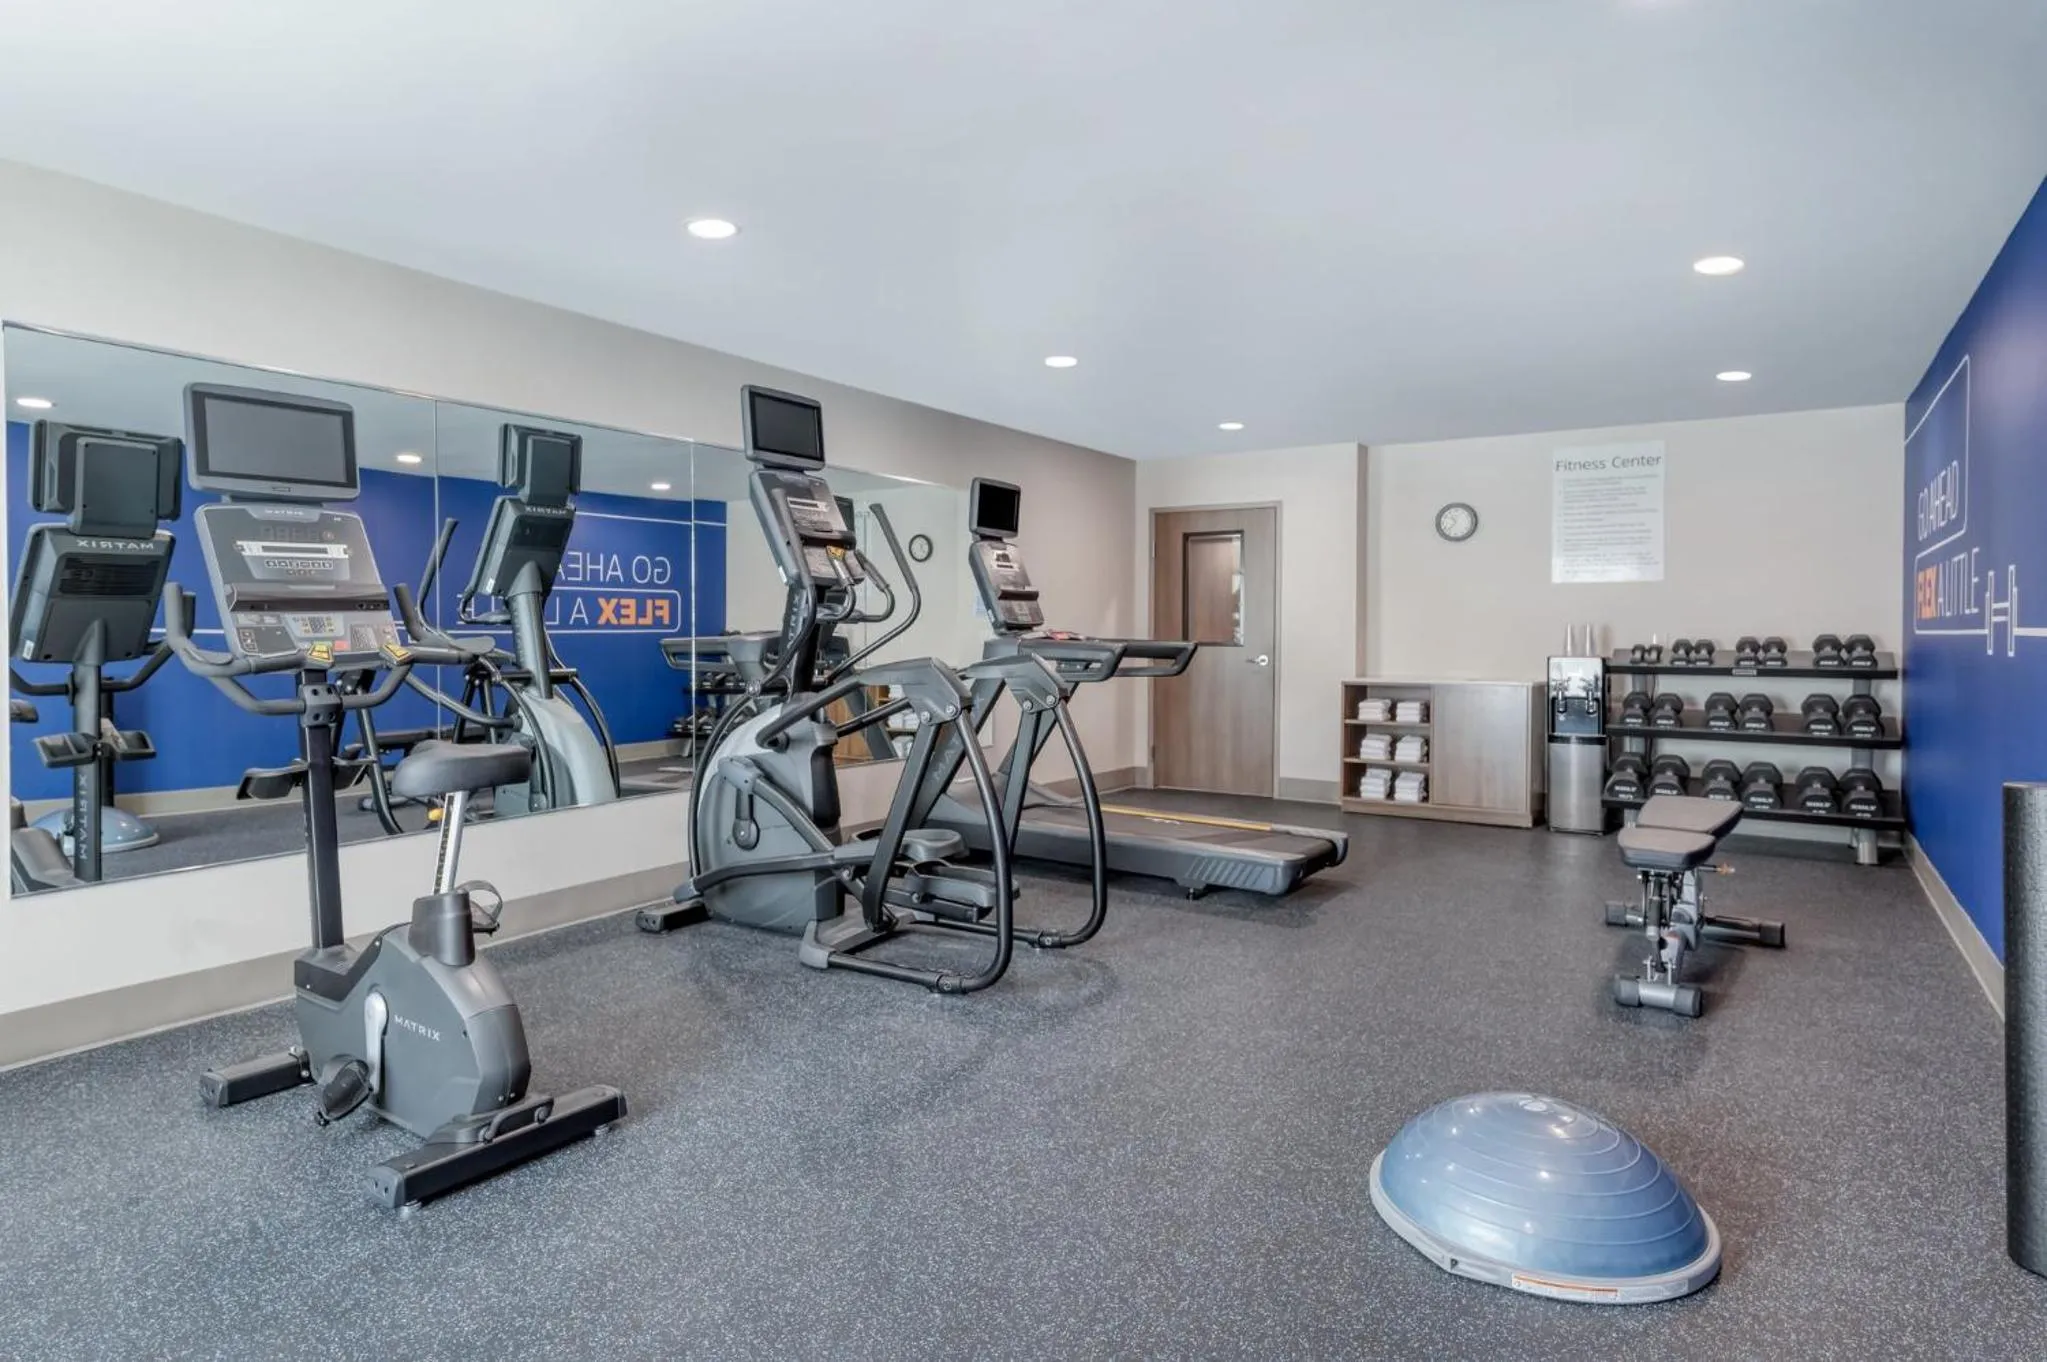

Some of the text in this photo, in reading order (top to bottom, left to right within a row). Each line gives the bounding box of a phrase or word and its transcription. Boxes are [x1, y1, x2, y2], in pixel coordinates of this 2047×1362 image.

[1555, 455, 1662, 472] Fitness Center
[1929, 459, 1959, 534] AHEAD
[1945, 547, 1980, 618] LITTLE
[394, 1014, 440, 1041] MATRIX
